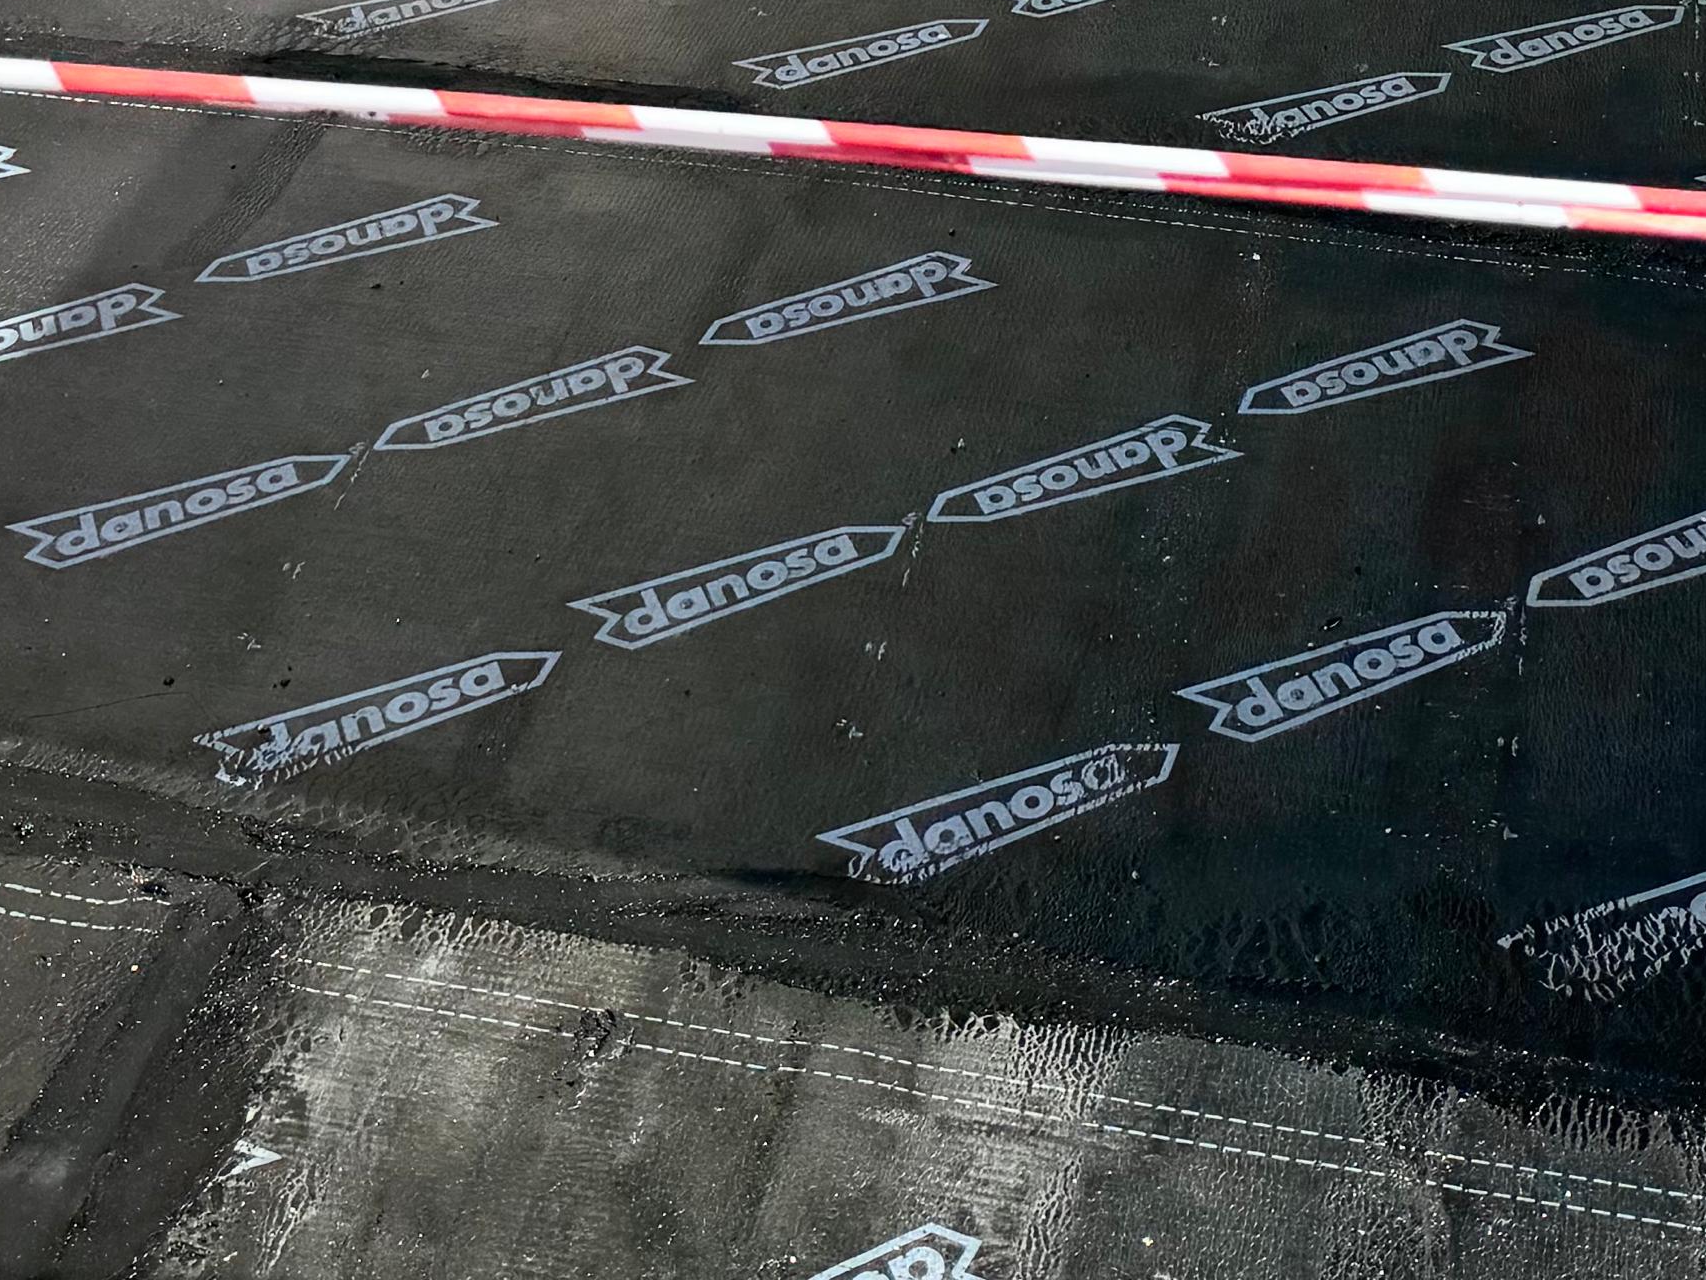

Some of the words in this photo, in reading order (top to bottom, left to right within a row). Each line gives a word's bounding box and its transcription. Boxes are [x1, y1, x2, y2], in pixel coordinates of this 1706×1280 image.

[777, 23, 955, 84] danosa
[1490, 2, 1662, 68] danosa
[241, 201, 460, 278] danosa
[742, 259, 952, 340] danosa
[422, 354, 651, 446] danosa
[1279, 327, 1481, 409] danosa
[56, 462, 299, 561] danosa
[971, 423, 1192, 517] danosa
[624, 533, 858, 641] danosa
[1235, 619, 1465, 734] danosa
